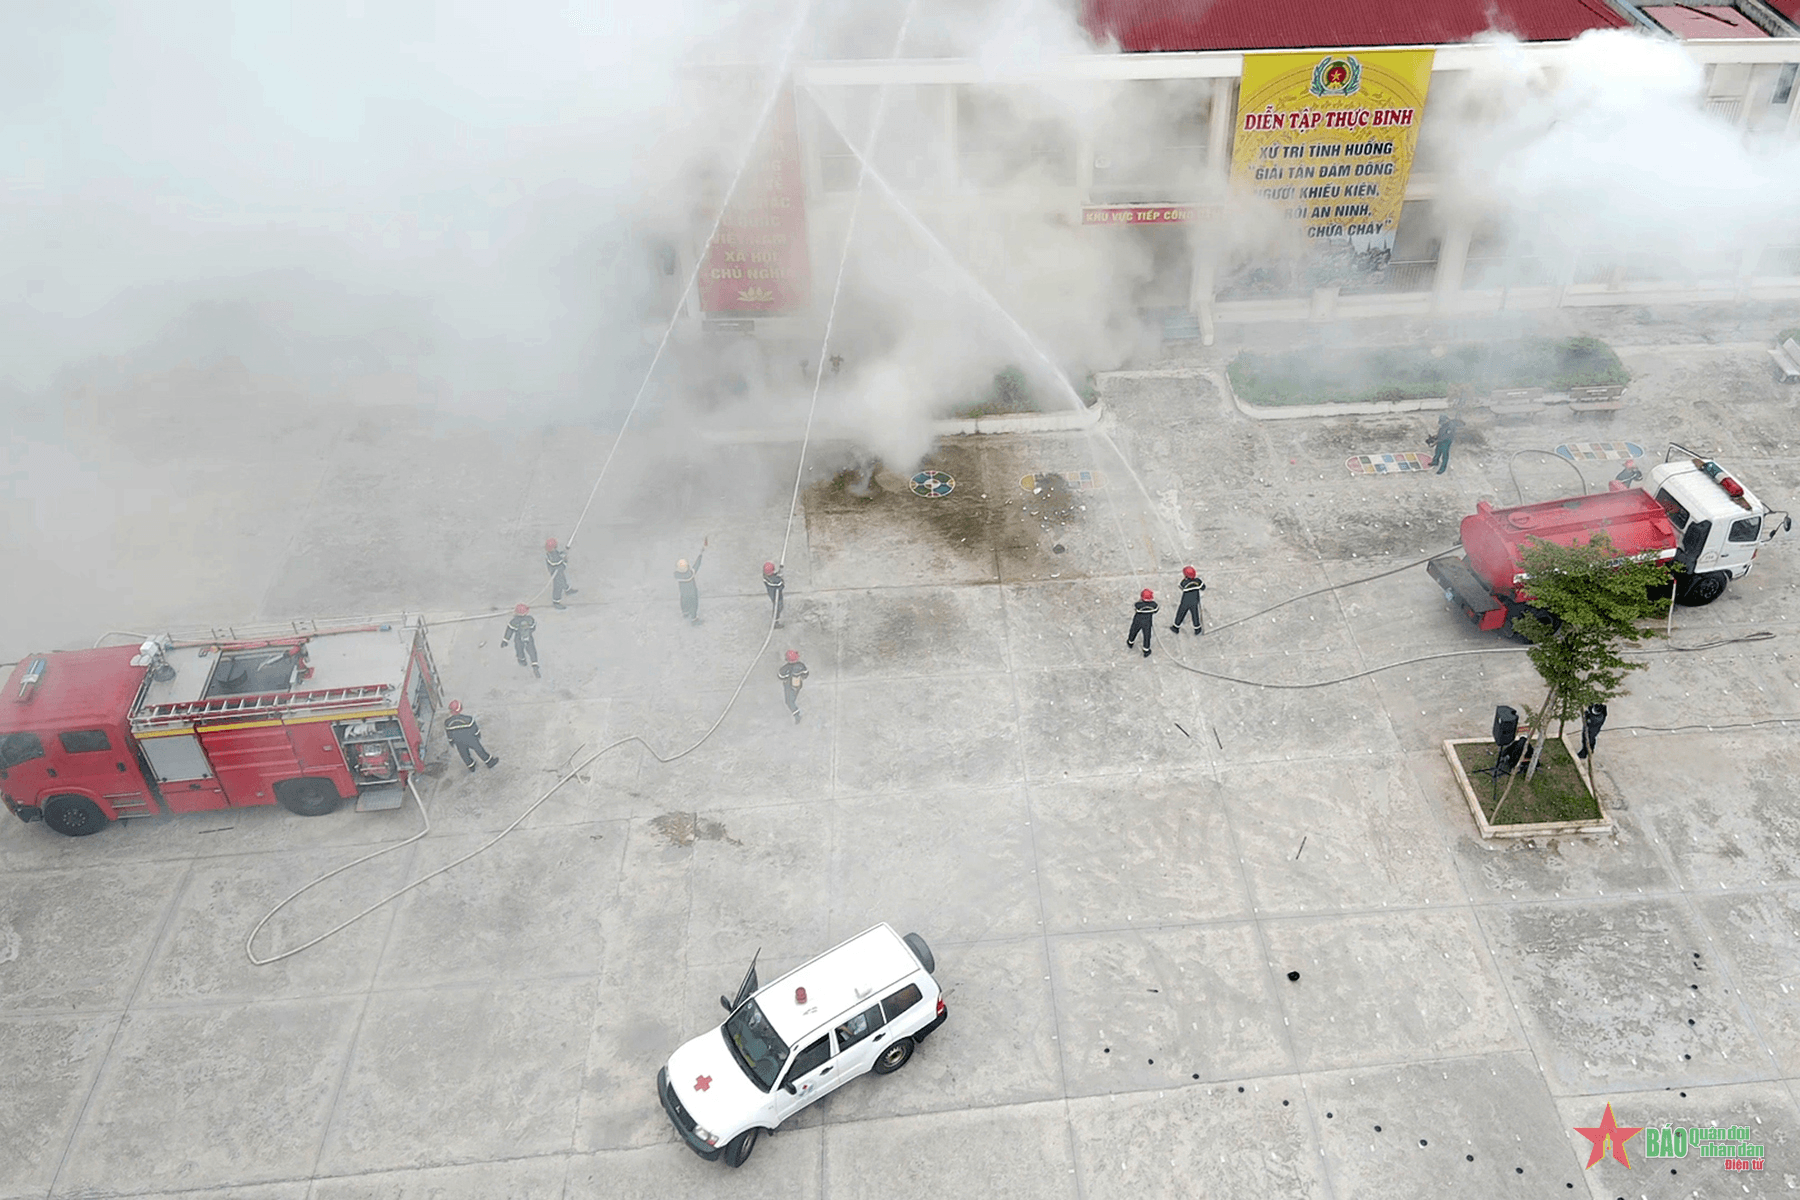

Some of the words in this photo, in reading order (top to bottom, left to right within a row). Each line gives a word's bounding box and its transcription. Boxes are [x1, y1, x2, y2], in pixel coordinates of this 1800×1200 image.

[1245, 105, 1285, 130] DIỄN
[1289, 108, 1321, 132] TẬP
[1325, 109, 1369, 130] THỰC
[1372, 109, 1413, 126] BINH
[1344, 137, 1393, 156] HUỐNG
[1086, 213, 1109, 223] KHU
[1311, 205, 1331, 218] AN
